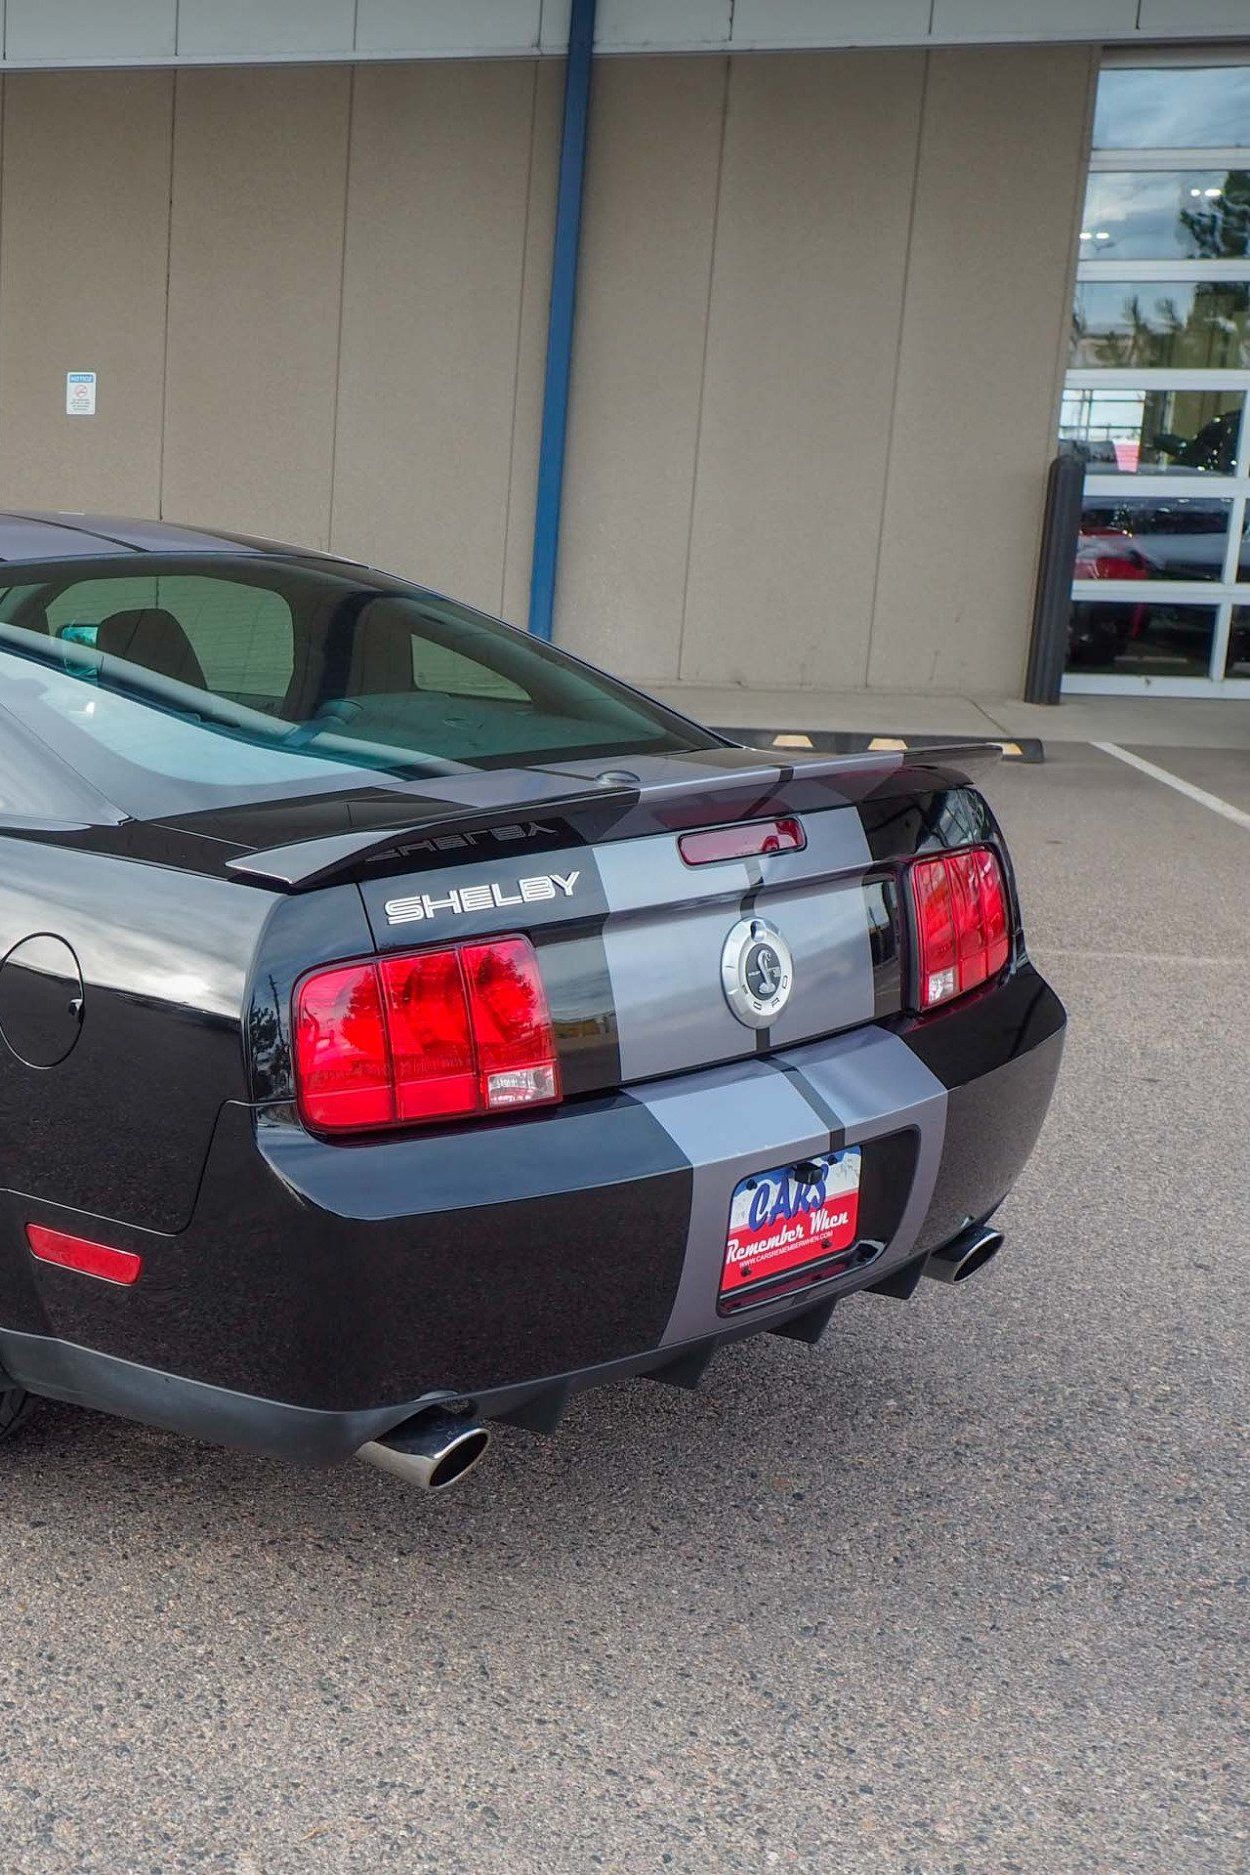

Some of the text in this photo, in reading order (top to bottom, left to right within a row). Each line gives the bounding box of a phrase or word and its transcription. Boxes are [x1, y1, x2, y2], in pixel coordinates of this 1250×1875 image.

[384, 870, 581, 925] SHELBY
[727, 1208, 849, 1264] Remember When
